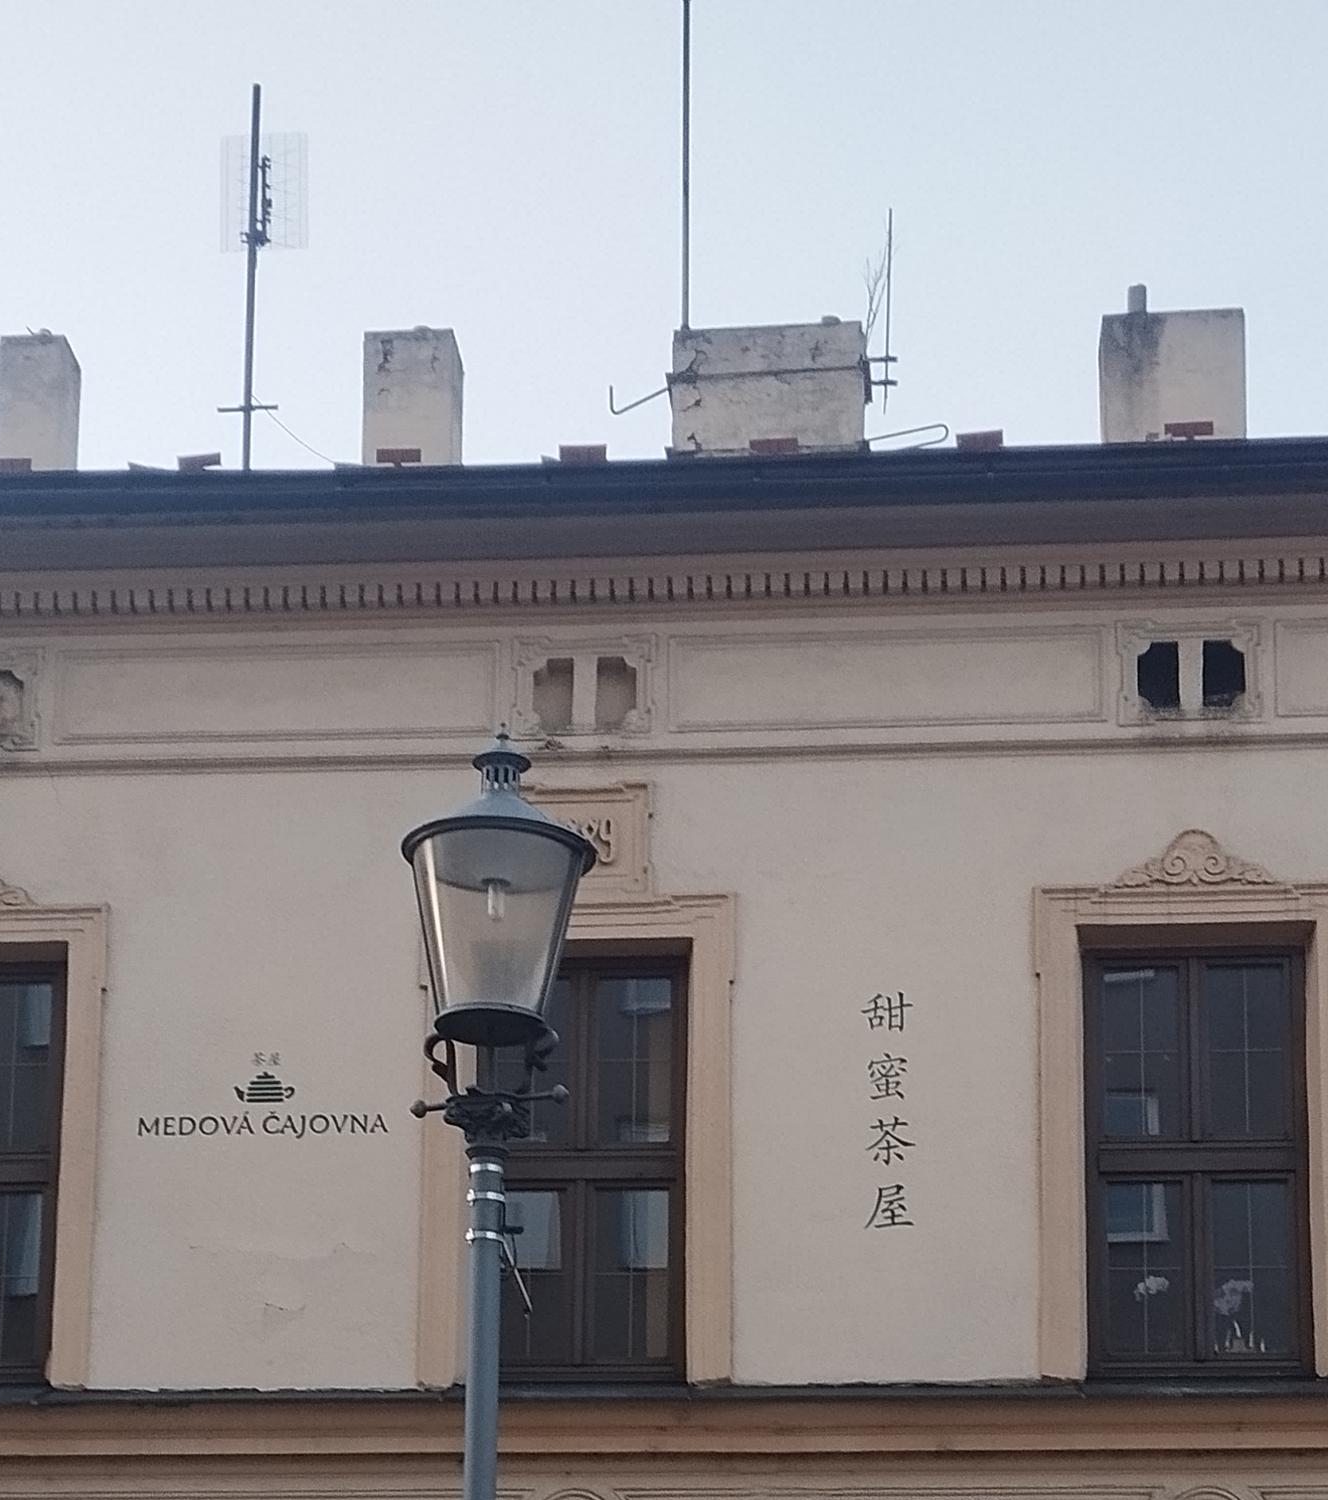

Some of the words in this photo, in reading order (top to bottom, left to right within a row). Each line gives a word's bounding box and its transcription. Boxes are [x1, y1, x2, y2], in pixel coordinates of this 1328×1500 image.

[137, 1111, 255, 1136] MEDOVÁ
[262, 1111, 389, 1139] ČAJOVNA
[860, 991, 916, 1229] 甜蜜茶屋
